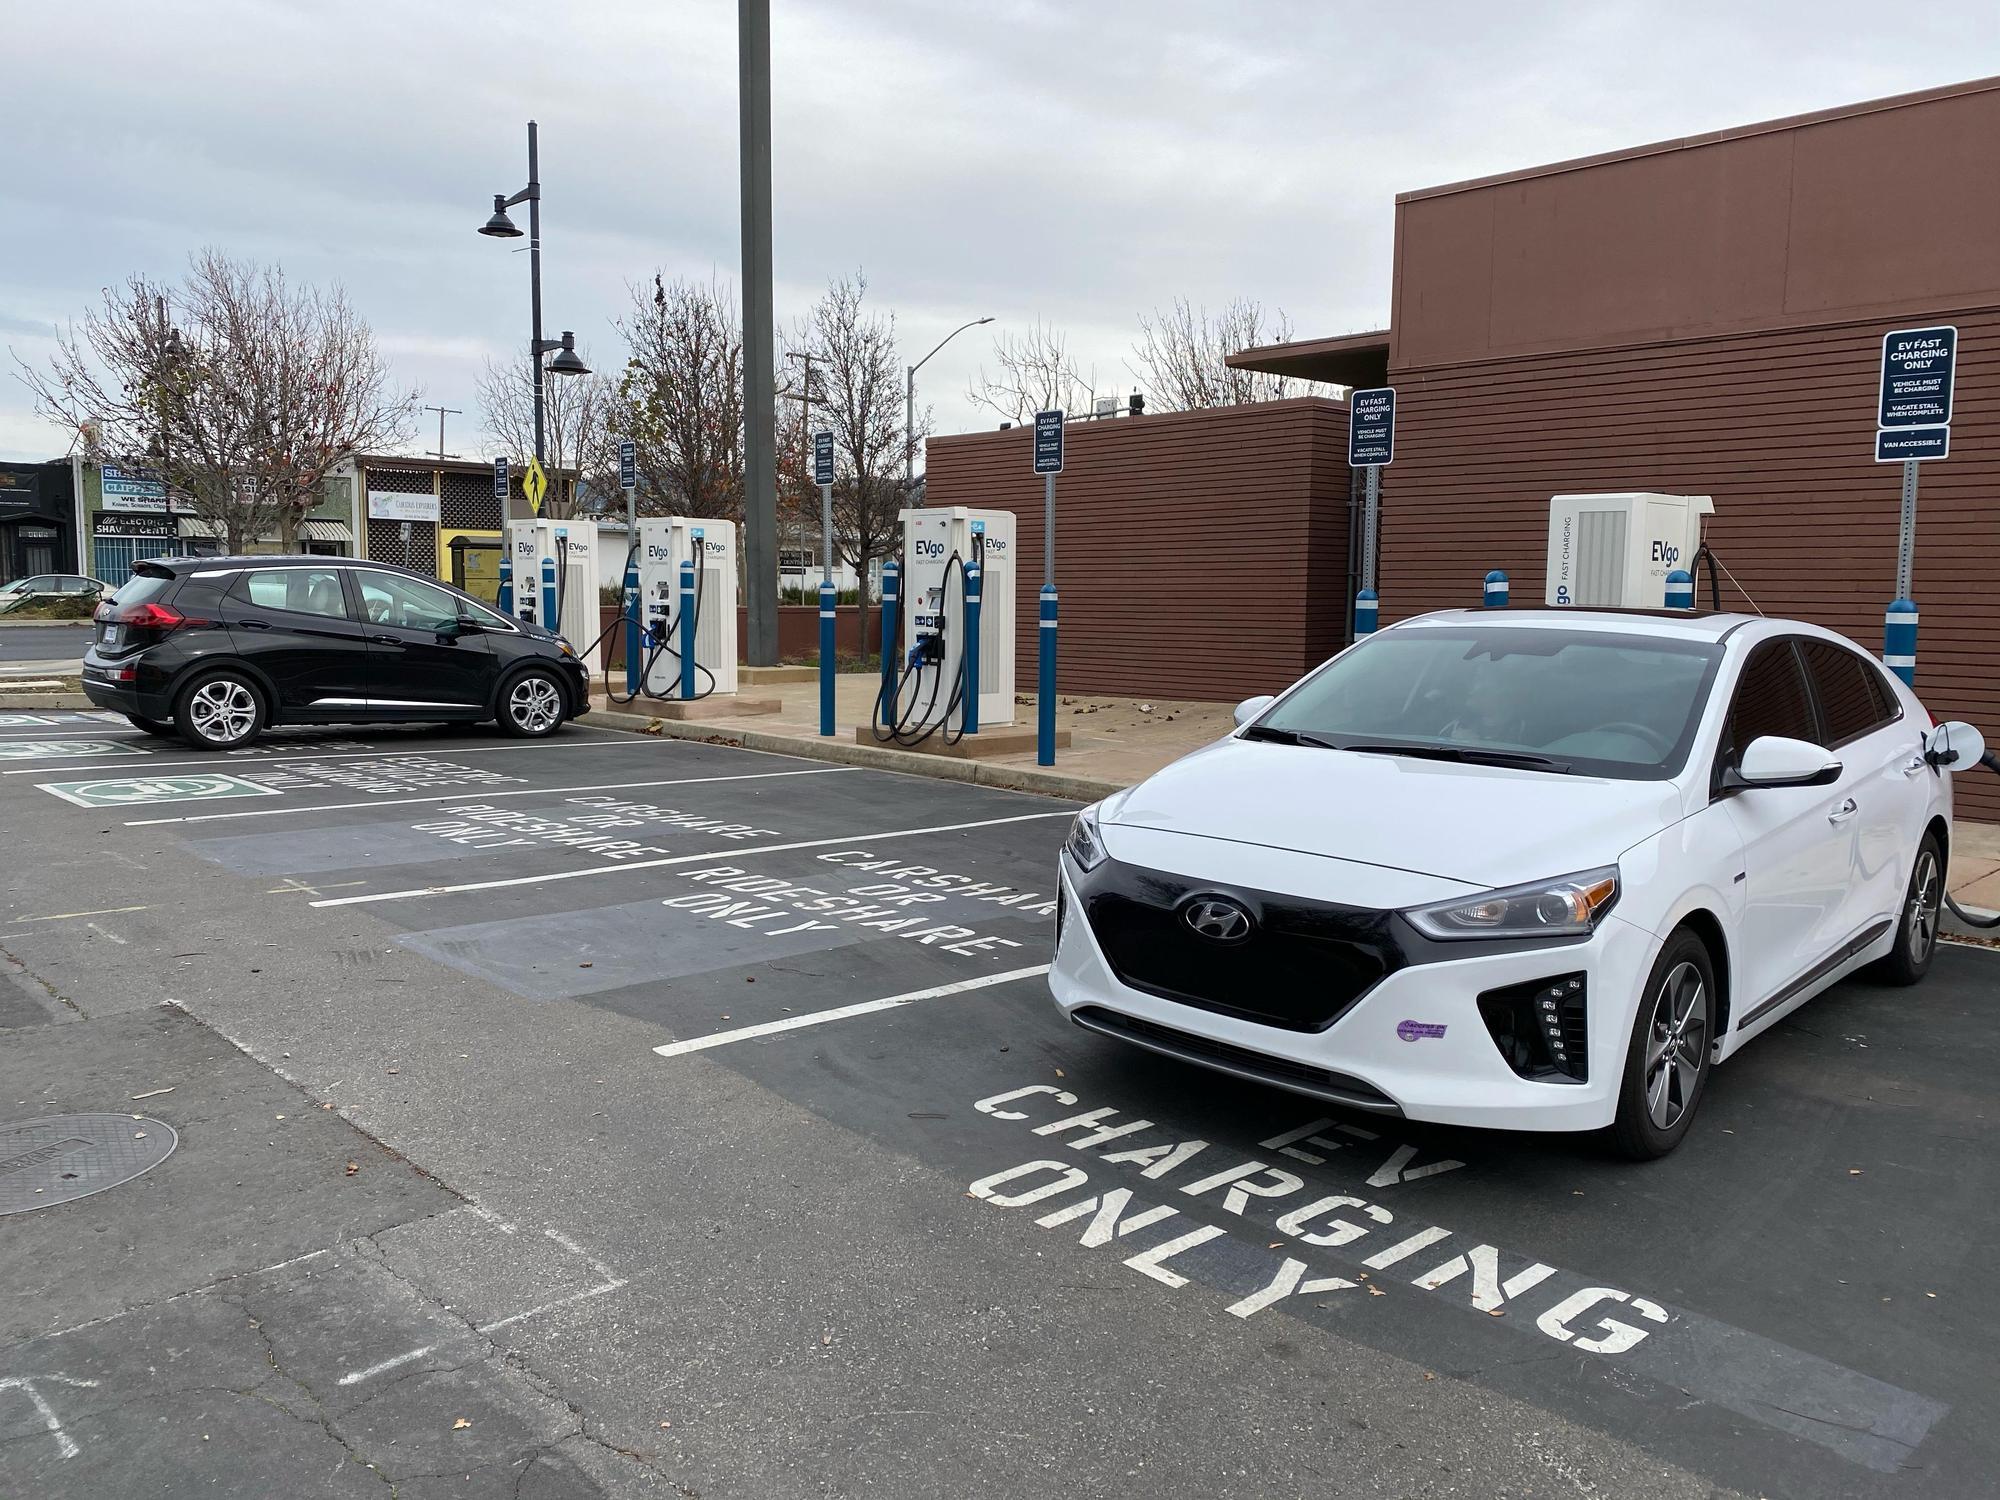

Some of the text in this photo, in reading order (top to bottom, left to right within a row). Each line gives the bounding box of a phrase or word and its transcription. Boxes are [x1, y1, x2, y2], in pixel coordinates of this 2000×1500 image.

[1898, 338, 1942, 350] EV FAST
[1890, 348, 1948, 360] CHARGING
[1904, 360, 1932, 370] ONLY
[1892, 380, 1921, 388] VEHICLE
[1904, 385, 1940, 393] CHARGING
[1356, 405, 1390, 414] CHARGING
[1899, 439, 1942, 447] ACCESSIBLE
[518, 542, 534, 555] EVgo
[569, 543, 588, 552] EVgo
[648, 545, 668, 560] EVgo
[706, 542, 725, 552] EVgo
[916, 540, 944, 558] EVgo
[986, 539, 1006, 551] EVgo
[1562, 516, 1571, 580] FAST CHARGING
[1652, 541, 1679, 568] EVgo
[1557, 585, 1570, 604] go
[237, 772, 332, 788] ONLY
[565, 796, 781, 840] CARSHARE
[567, 814, 644, 828] OR
[411, 821, 538, 848] ONLY
[436, 804, 670, 859] RIDESHARE
[816, 850, 1056, 916] CARSHAR
[848, 884, 947, 906] OR
[662, 893, 840, 936] ONLY
[676, 866, 1024, 957] RIDESHARE
[1258, 1117, 1467, 1188] EV
[972, 1084, 1670, 1355] CHARGING
[968, 1160, 1360, 1320] ONLY
